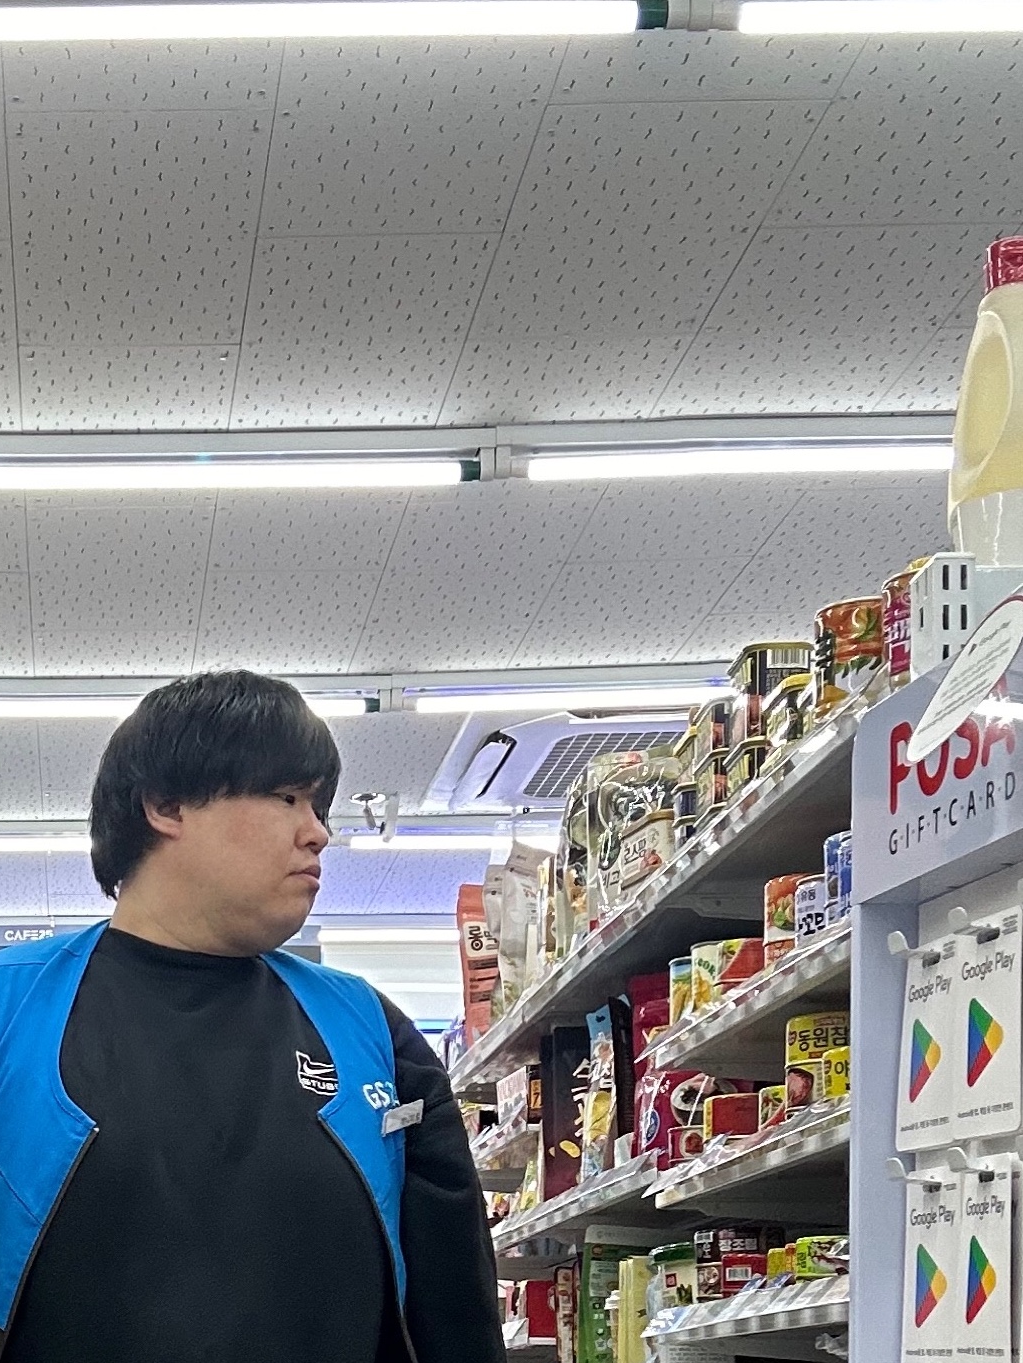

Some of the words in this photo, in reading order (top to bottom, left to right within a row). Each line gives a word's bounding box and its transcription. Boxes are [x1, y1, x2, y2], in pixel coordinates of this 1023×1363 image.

[962, 956, 993, 984] Google
[994, 950, 1016, 974] Play
[908, 979, 936, 1003] Google
[936, 974, 953, 996] Play
[910, 1208, 937, 1229] Google
[938, 1204, 955, 1228] Play
[966, 1196, 990, 1220] Google
[990, 1194, 1006, 1218] Play
